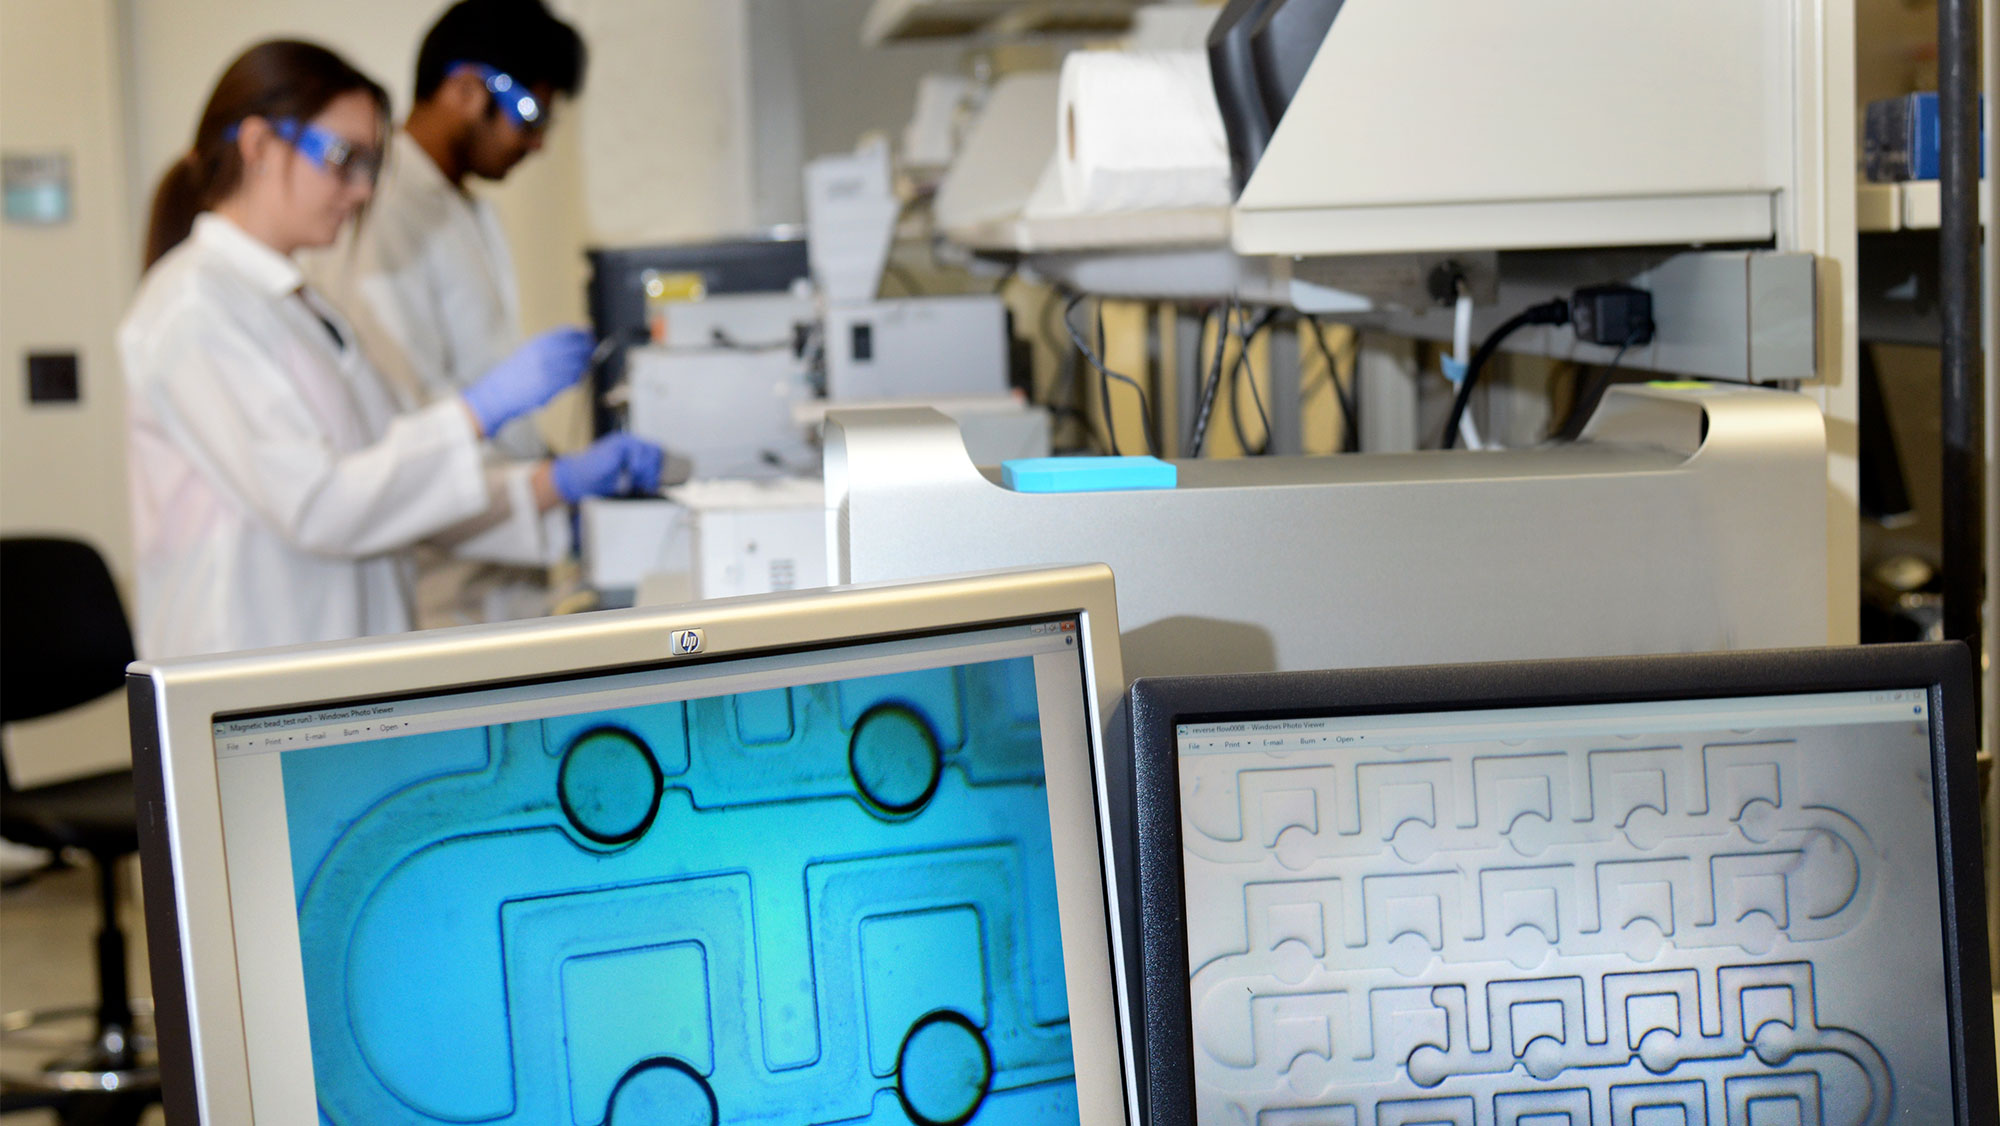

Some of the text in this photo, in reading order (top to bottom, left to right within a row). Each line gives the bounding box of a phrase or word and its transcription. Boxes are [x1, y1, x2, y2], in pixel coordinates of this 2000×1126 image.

[682, 630, 698, 653] hp
[230, 721, 262, 733] Magnetic
[264, 718, 296, 728] bead_test
[297, 715, 313, 724] run3
[319, 711, 350, 721] Windows
[351, 709, 371, 717] Photo
[372, 706, 394, 715] Viewer
[1251, 722, 1281, 731] Windows
[1282, 721, 1302, 729] Photo
[1303, 720, 1325, 728] Viewer
[226, 723, 398, 751] File Print E-mail Burn Open
[1263, 738, 1284, 746] E-mail
[1300, 737, 1316, 745] Burn
[1336, 735, 1354, 744] Open
